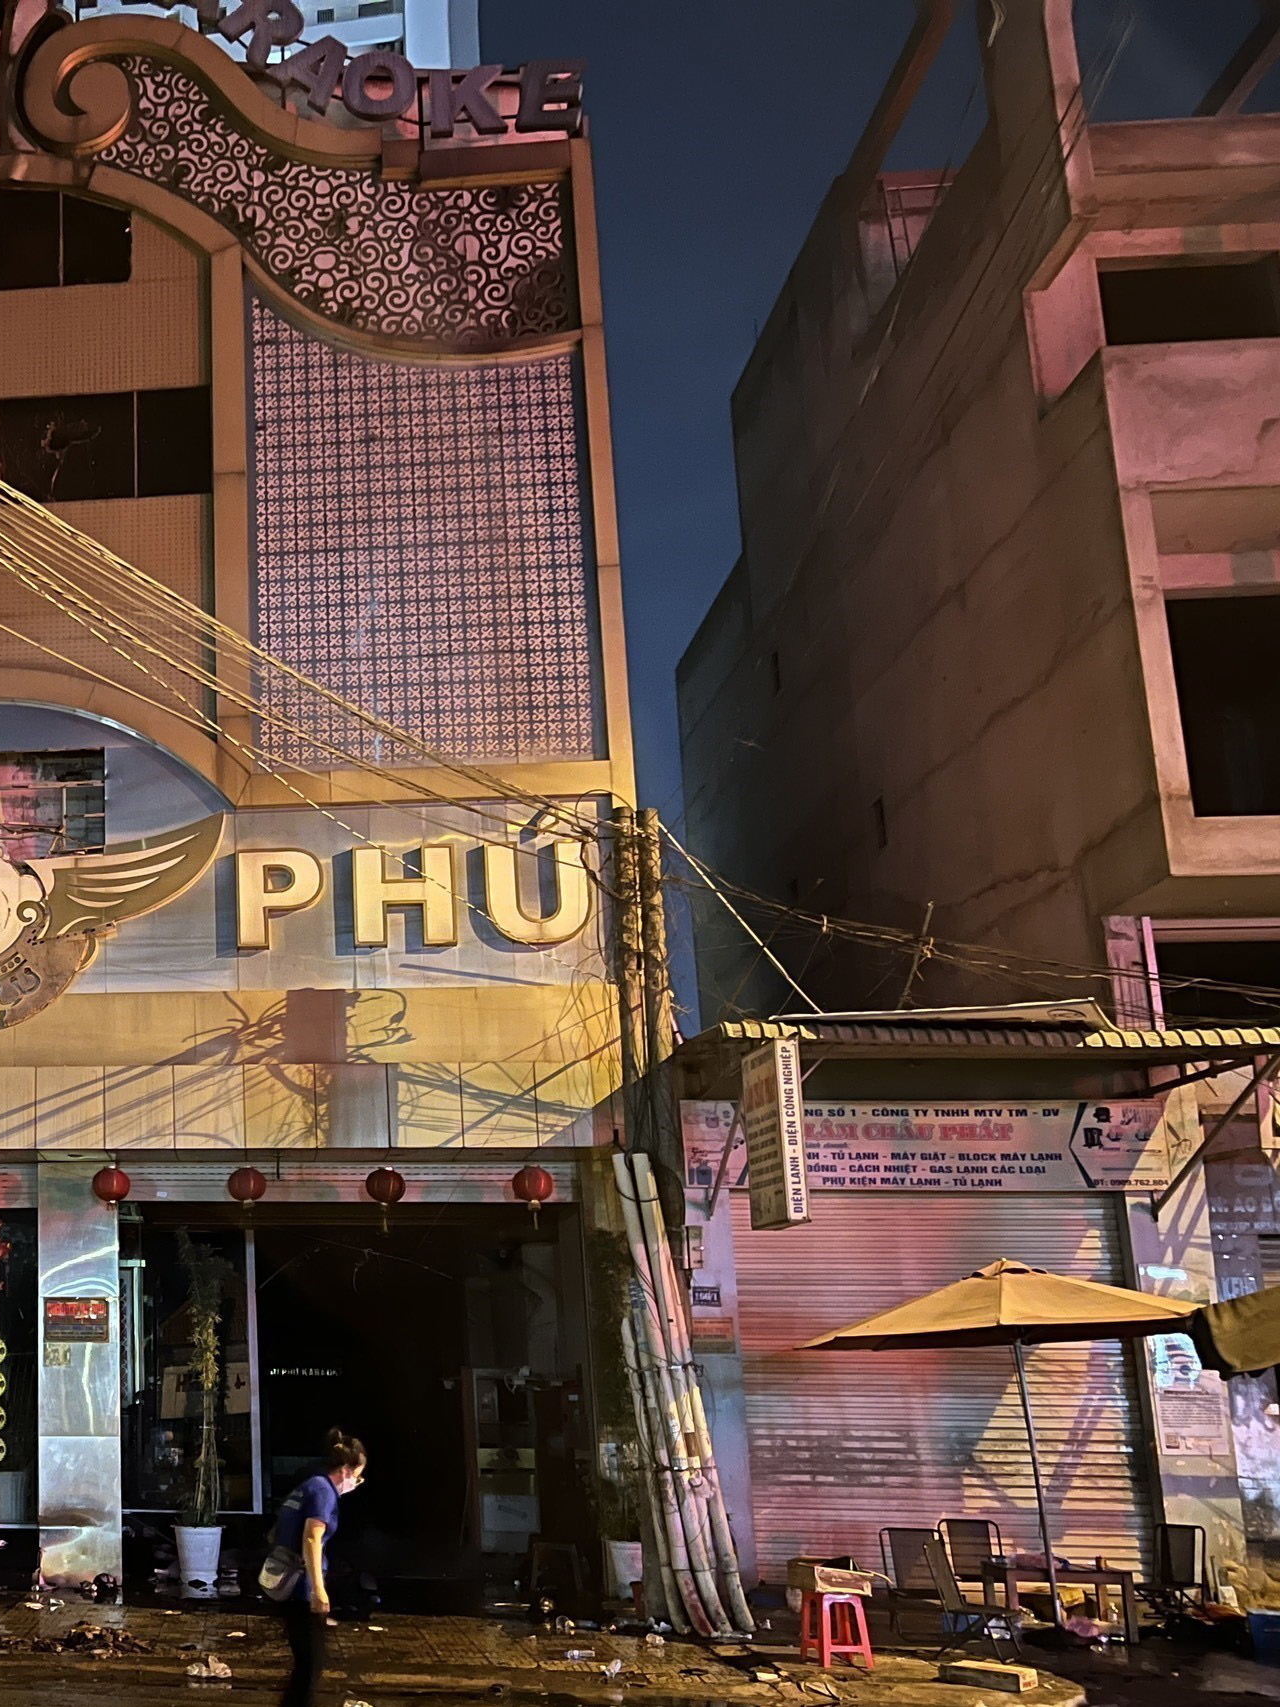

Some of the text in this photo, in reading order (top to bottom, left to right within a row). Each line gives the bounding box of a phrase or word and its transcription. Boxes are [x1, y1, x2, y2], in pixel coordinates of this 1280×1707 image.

[236, 806, 592, 951] PHÚ
[779, 1046, 793, 1085] NGHIỆP
[783, 1088, 796, 1117] CÔNG
[850, 1109, 857, 1117] 1
[871, 1106, 909, 1117] CÔNG
[913, 1109, 929, 1117] TY
[933, 1109, 970, 1117] TNHH
[974, 1109, 1003, 1117] MTV
[1007, 1109, 1028, 1117] TM
[1042, 1108, 1060, 1117] DV
[848, 1152, 879, 1162] LẠNH
[891, 1151, 917, 1160] MÁY
[958, 1153, 996, 1161] BLOCK
[1000, 1151, 1027, 1161] MÁY
[1031, 1153, 1063, 1163] LẠNH
[789, 1156, 803, 1185] LẠNH
[849, 1162, 880, 1173] CÁCH
[929, 1165, 953, 1174] GAS
[956, 1166, 988, 1175] LẠNH
[991, 1164, 1016, 1174] CÁC
[1020, 1166, 1046, 1175] LOẠI
[880, 1176, 907, 1186] MÁY
[910, 1178, 941, 1188] LẠNH
[971, 1178, 1003, 1189] LẠNH
